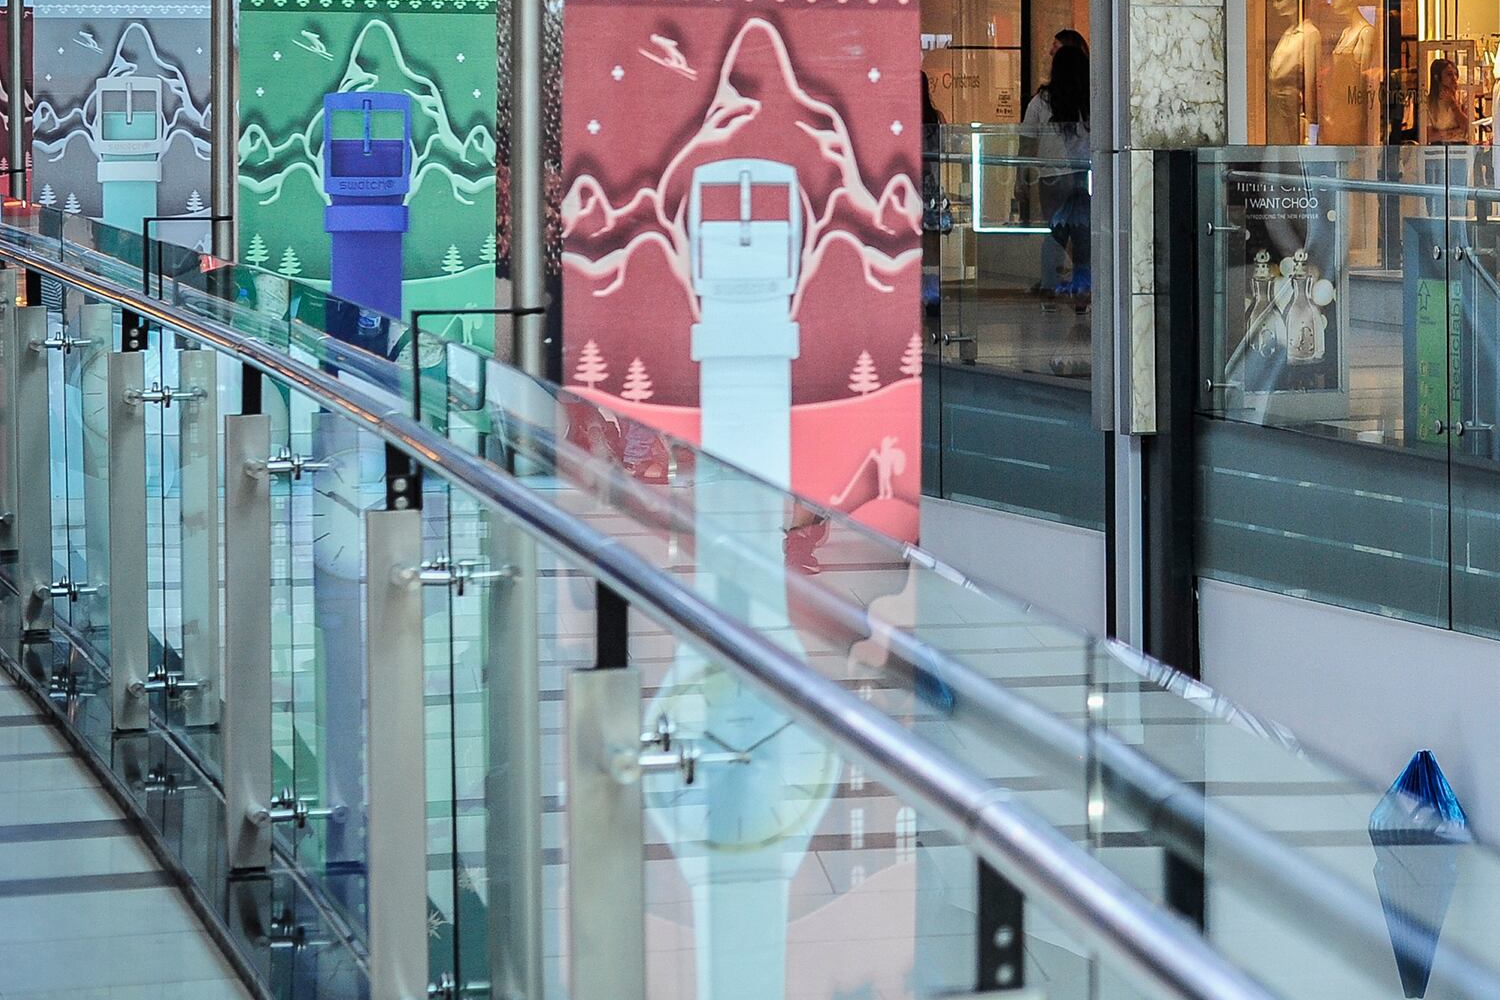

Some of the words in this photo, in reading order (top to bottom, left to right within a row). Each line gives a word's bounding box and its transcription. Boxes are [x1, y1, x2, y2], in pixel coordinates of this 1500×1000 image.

[1249, 197, 1280, 209] WANT
[1281, 197, 1318, 209] CHOO
[1450, 282, 1463, 402] Reciclable
